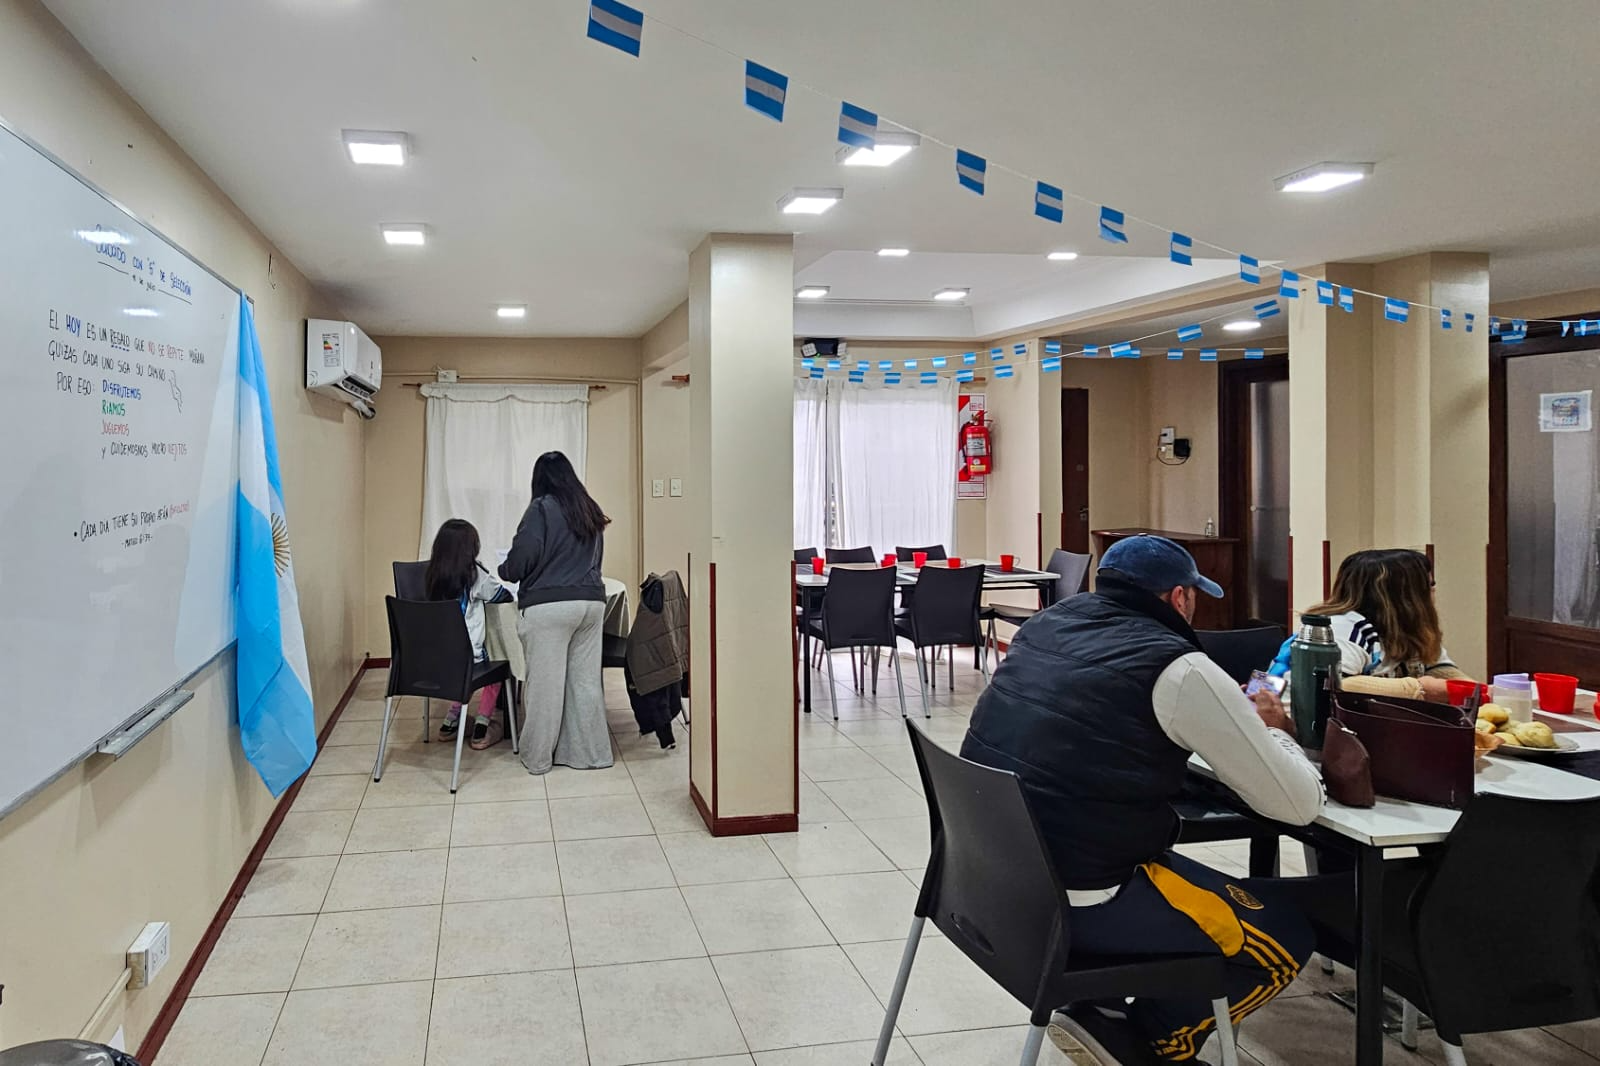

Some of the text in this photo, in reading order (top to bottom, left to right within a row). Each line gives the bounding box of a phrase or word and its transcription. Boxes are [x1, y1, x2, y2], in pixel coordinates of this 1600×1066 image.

[132, 256, 144, 271] CON
[159, 269, 166, 283] DE
[49, 308, 59, 330] EL
[66, 314, 81, 337] HOY
[87, 322, 97, 342] ES
[100, 327, 108, 342] UN
[110, 328, 130, 348] REGALO
[134, 337, 145, 353] QUE
[148, 341, 156, 356] NO
[158, 343, 165, 358] SE
[83, 350, 99, 367] CADA
[102, 356, 114, 370] UNO
[136, 362, 144, 377] SU
[57, 371, 73, 394] POR
[101, 418, 130, 437] JUGUEMOS
[80, 520, 97, 543] CADA
[131, 512, 138, 528] SU
